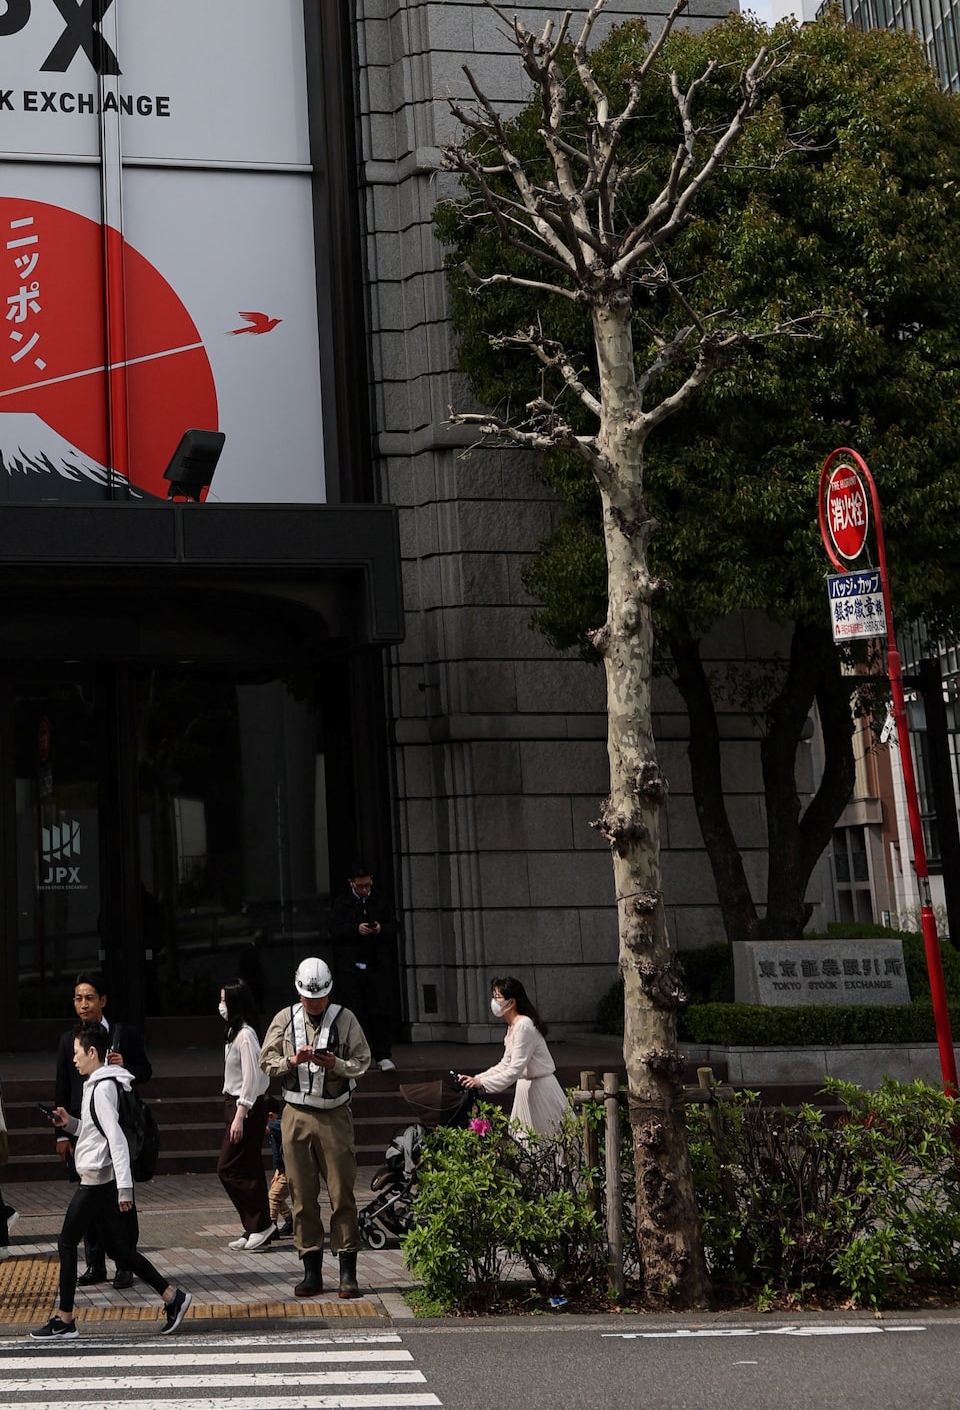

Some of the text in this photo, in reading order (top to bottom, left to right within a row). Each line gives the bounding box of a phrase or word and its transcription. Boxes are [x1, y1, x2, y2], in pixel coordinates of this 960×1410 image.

[23, 90, 171, 117] EXCHANGE
[5, 216, 47, 371] ニッポン、
[830, 490, 865, 532] 消火栓
[44, 866, 81, 883] JPX
[772, 980, 893, 990] TOKYO STOCK EXCHANGE
